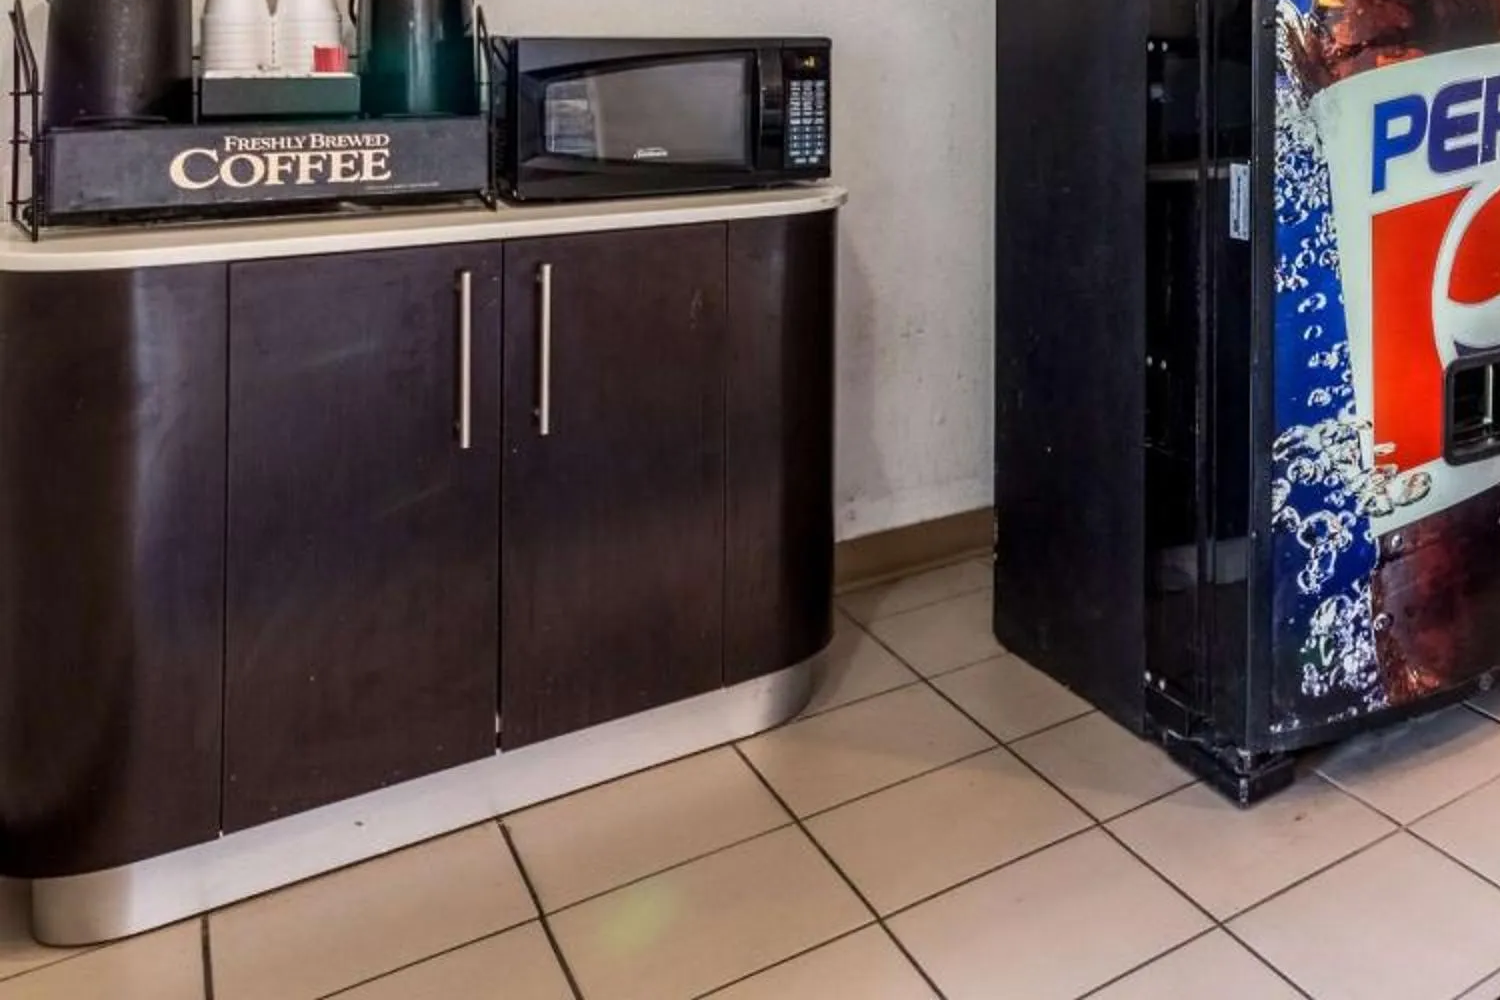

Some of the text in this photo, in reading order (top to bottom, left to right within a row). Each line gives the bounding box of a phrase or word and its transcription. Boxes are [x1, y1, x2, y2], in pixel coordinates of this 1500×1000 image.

[224, 133, 391, 151] FRESHLY BREWED
[169, 149, 392, 189] COFFEE
